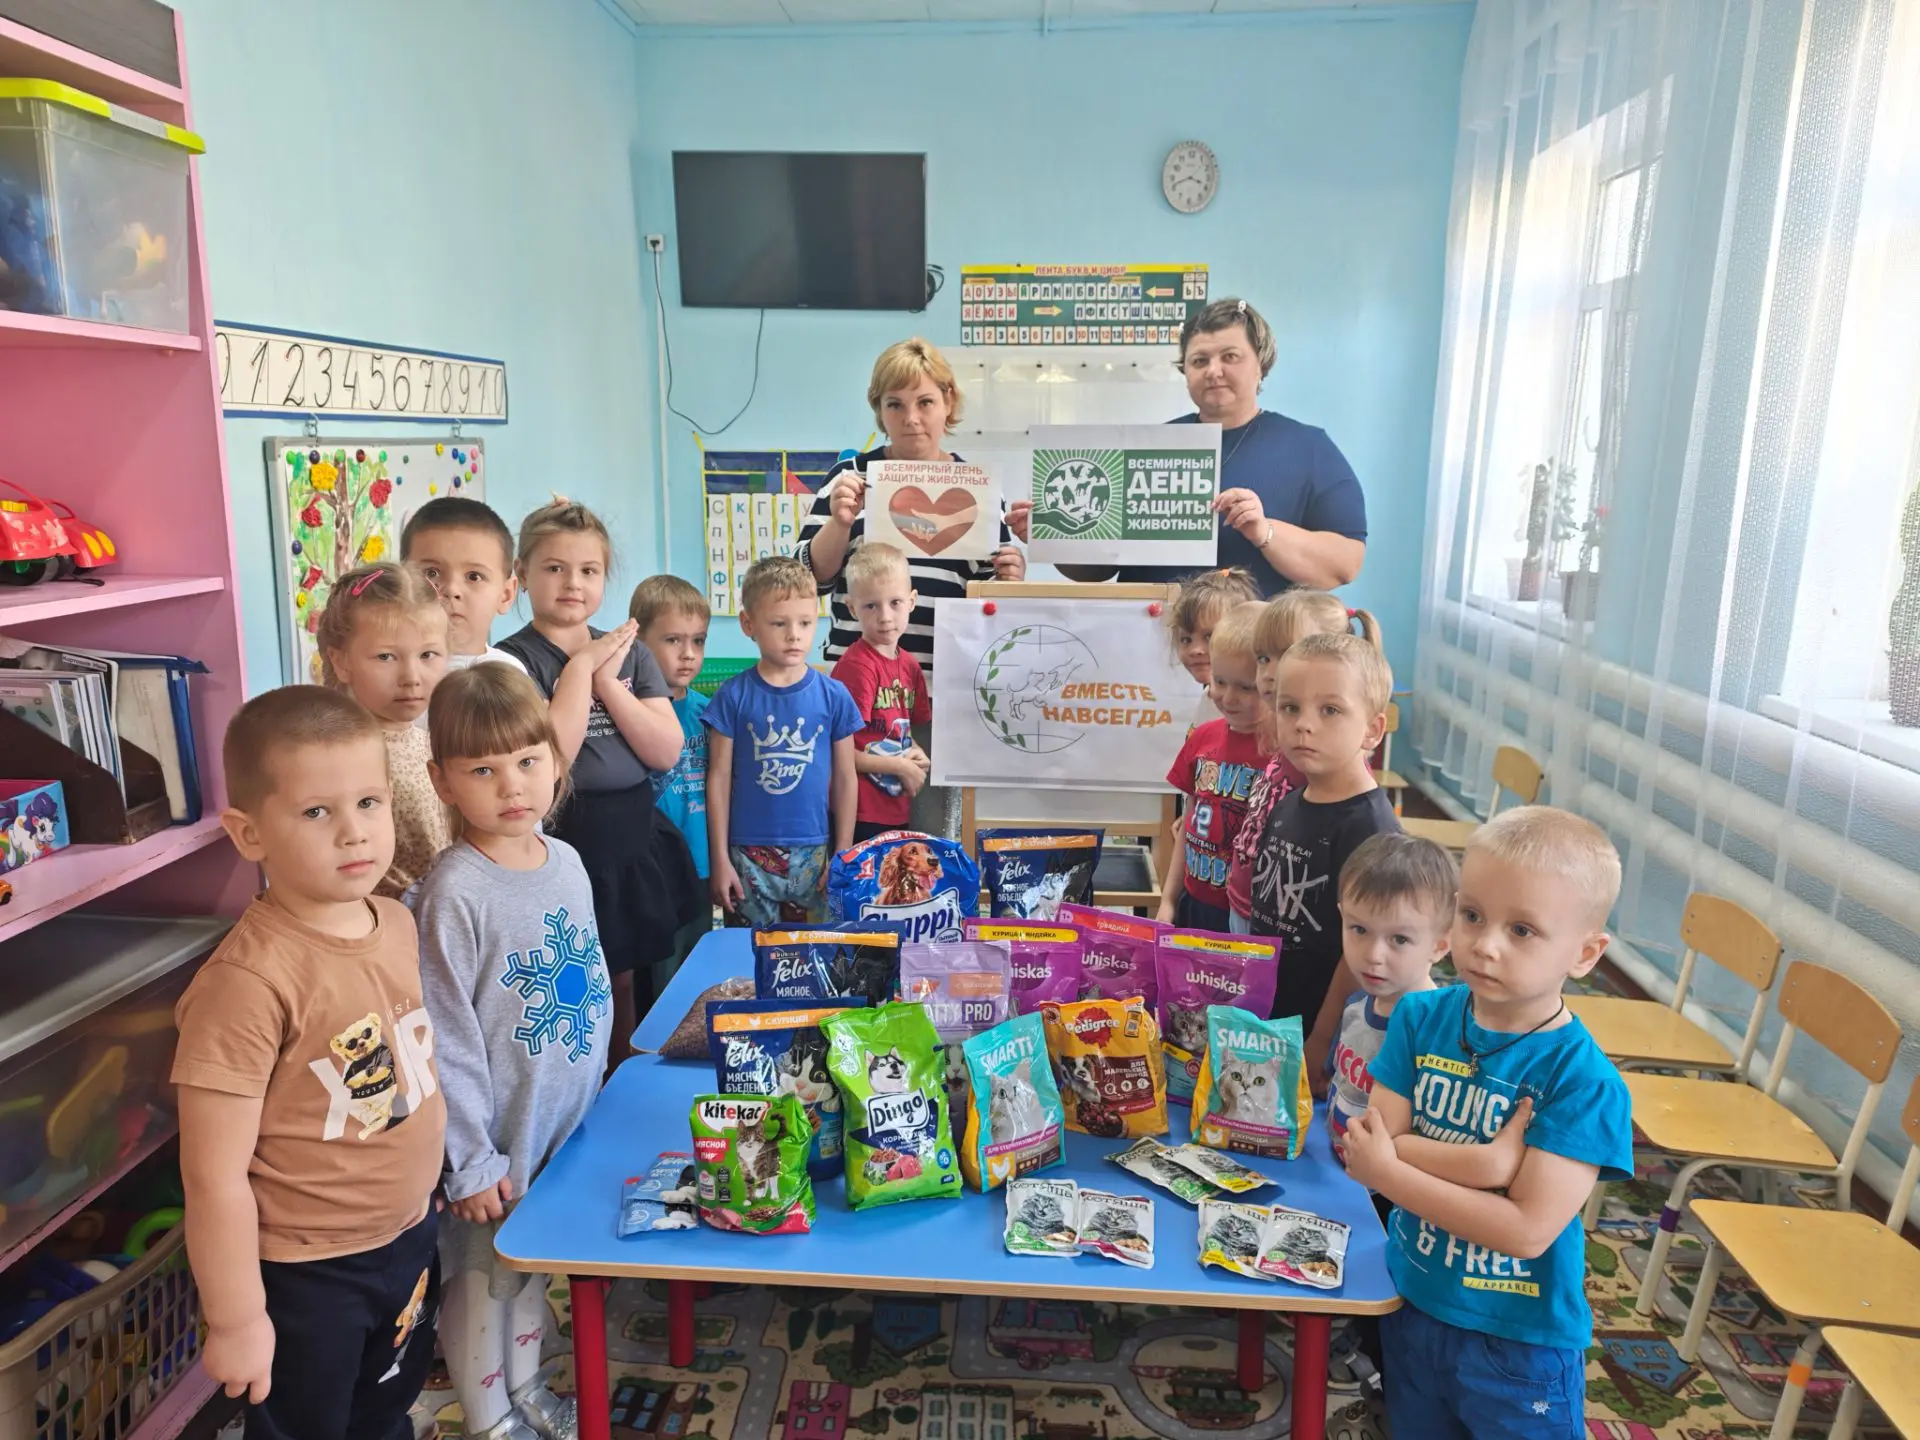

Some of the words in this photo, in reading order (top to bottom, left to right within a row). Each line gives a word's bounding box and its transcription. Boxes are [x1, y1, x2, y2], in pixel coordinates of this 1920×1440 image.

[1035, 266, 1064, 274] ЛЕНТА
[1066, 266, 1089, 274] БУКВ
[1099, 266, 1126, 275] ЦИФР
[1078, 331, 1086, 339] 10
[1091, 331, 1098, 339] 11
[1102, 331, 1110, 339] 12
[1113, 331, 1121, 339] 13
[1125, 331, 1134, 339] 14
[1136, 331, 1145, 339] 15
[1148, 331, 1156, 339] 16
[1160, 331, 1168, 339] 17
[252, 339, 269, 403] 1
[283, 344, 304, 407] 2
[314, 347, 332, 407] 3
[343, 350, 358, 408] 4
[370, 354, 386, 410] 5
[393, 357, 411, 411] 6
[419, 360, 434, 412] 7
[440, 362, 452, 413] 8
[459, 365, 470, 413] 9
[884, 463, 952, 474] ВСЕМИРНЫЙ
[954, 466, 983, 475] ДЕНЬ
[1128, 456, 1213, 469] ВСЕМИРНЫЙ
[878, 473, 924, 484] ЗАЩИТЫ
[927, 475, 989, 486] ЖИВОТНЫХ
[1126, 471, 1213, 499] ДЕНЬ
[1126, 500, 1212, 517] ЗАЩИТЫ
[1127, 519, 1212, 530] ЖИВОТНЫХ
[1060, 682, 1157, 702] ВМЕСТЕ
[1042, 706, 1173, 728] НАВСЕГДА
[756, 759, 807, 796] King
[998, 861, 1031, 886] felix
[772, 959, 814, 989] felix
[1185, 970, 1247, 996] whiskas
[776, 985, 811, 998] МЯСНОЕ
[965, 1003, 993, 1021] PRO
[1065, 1018, 1121, 1034] Pedigree
[704, 1102, 761, 1120] kitekat
[872, 1095, 923, 1127] Dingo
[1413, 1071, 1511, 1139] YOUNG
[695, 1139, 726, 1149] МЯСНОЙ
